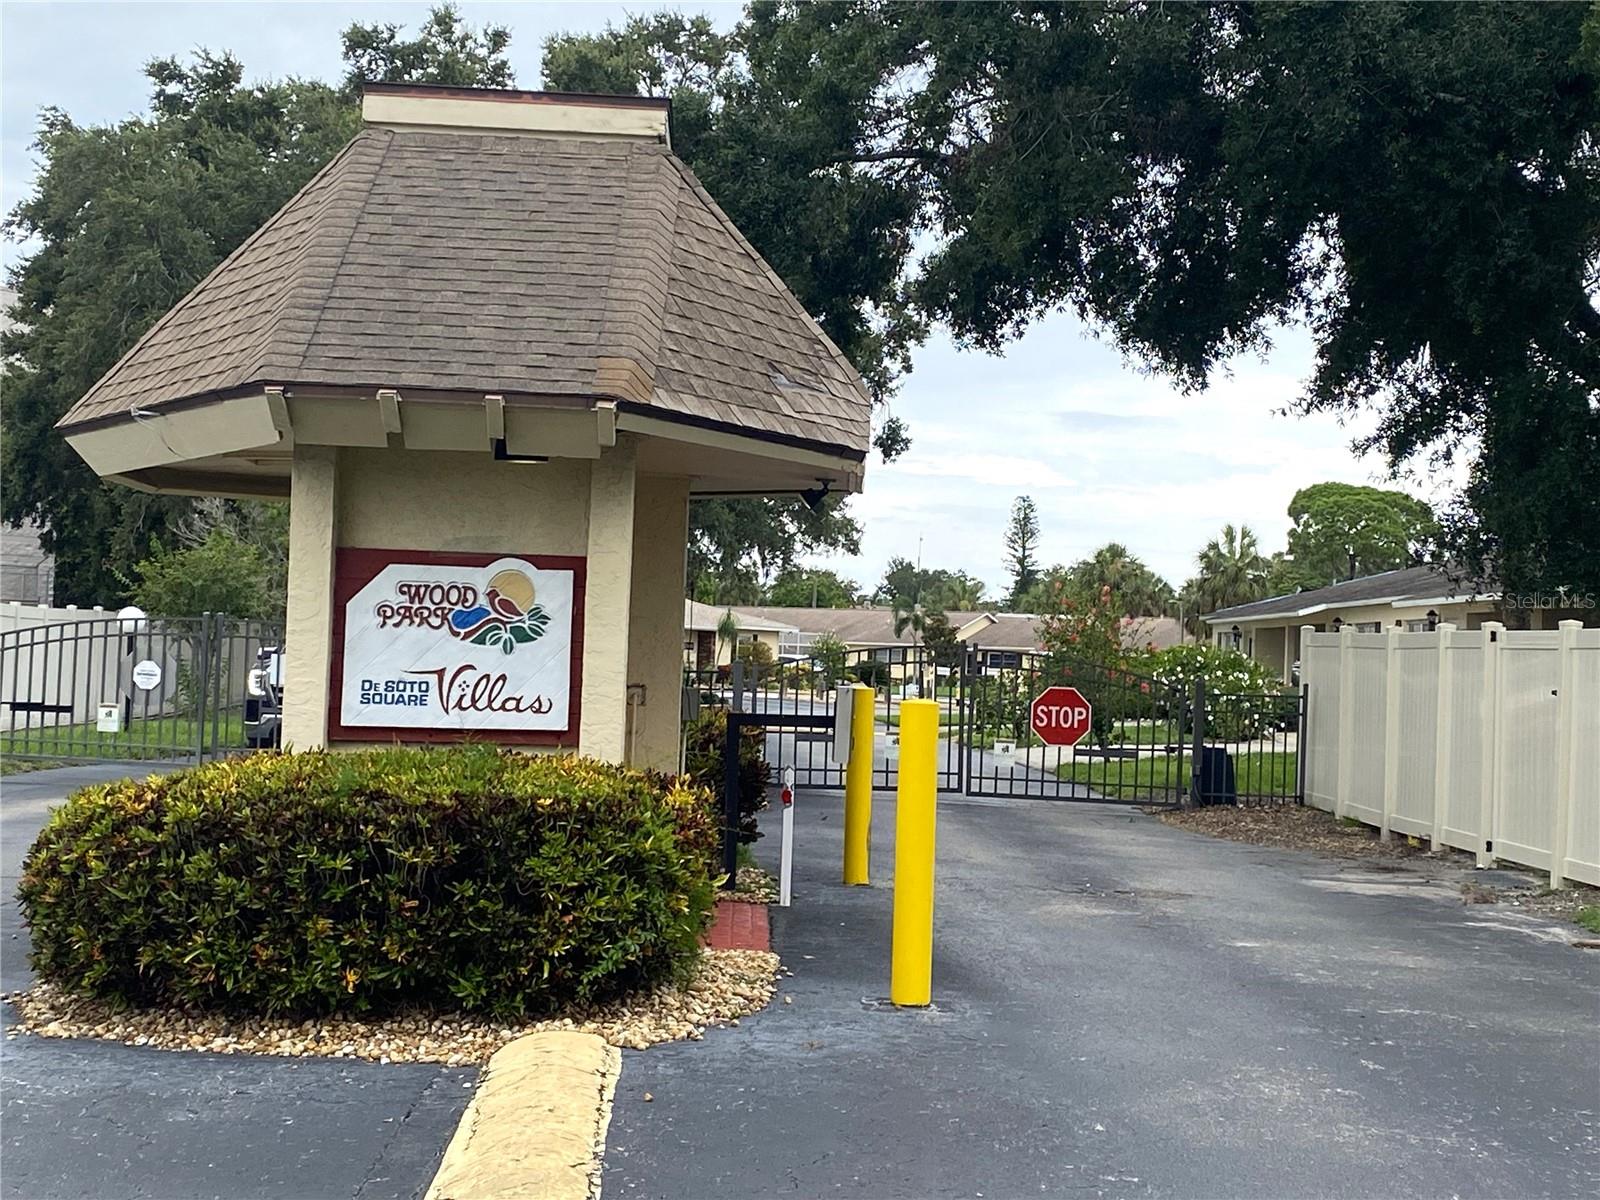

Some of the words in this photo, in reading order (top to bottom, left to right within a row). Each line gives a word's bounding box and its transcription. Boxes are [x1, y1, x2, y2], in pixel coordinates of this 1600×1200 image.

[398, 583, 477, 609] WOOD
[376, 604, 461, 637] PARK
[359, 692, 429, 706] SQUARE
[384, 680, 429, 693] SOTO
[401, 664, 553, 716] Villas
[1035, 705, 1087, 729] STOP
